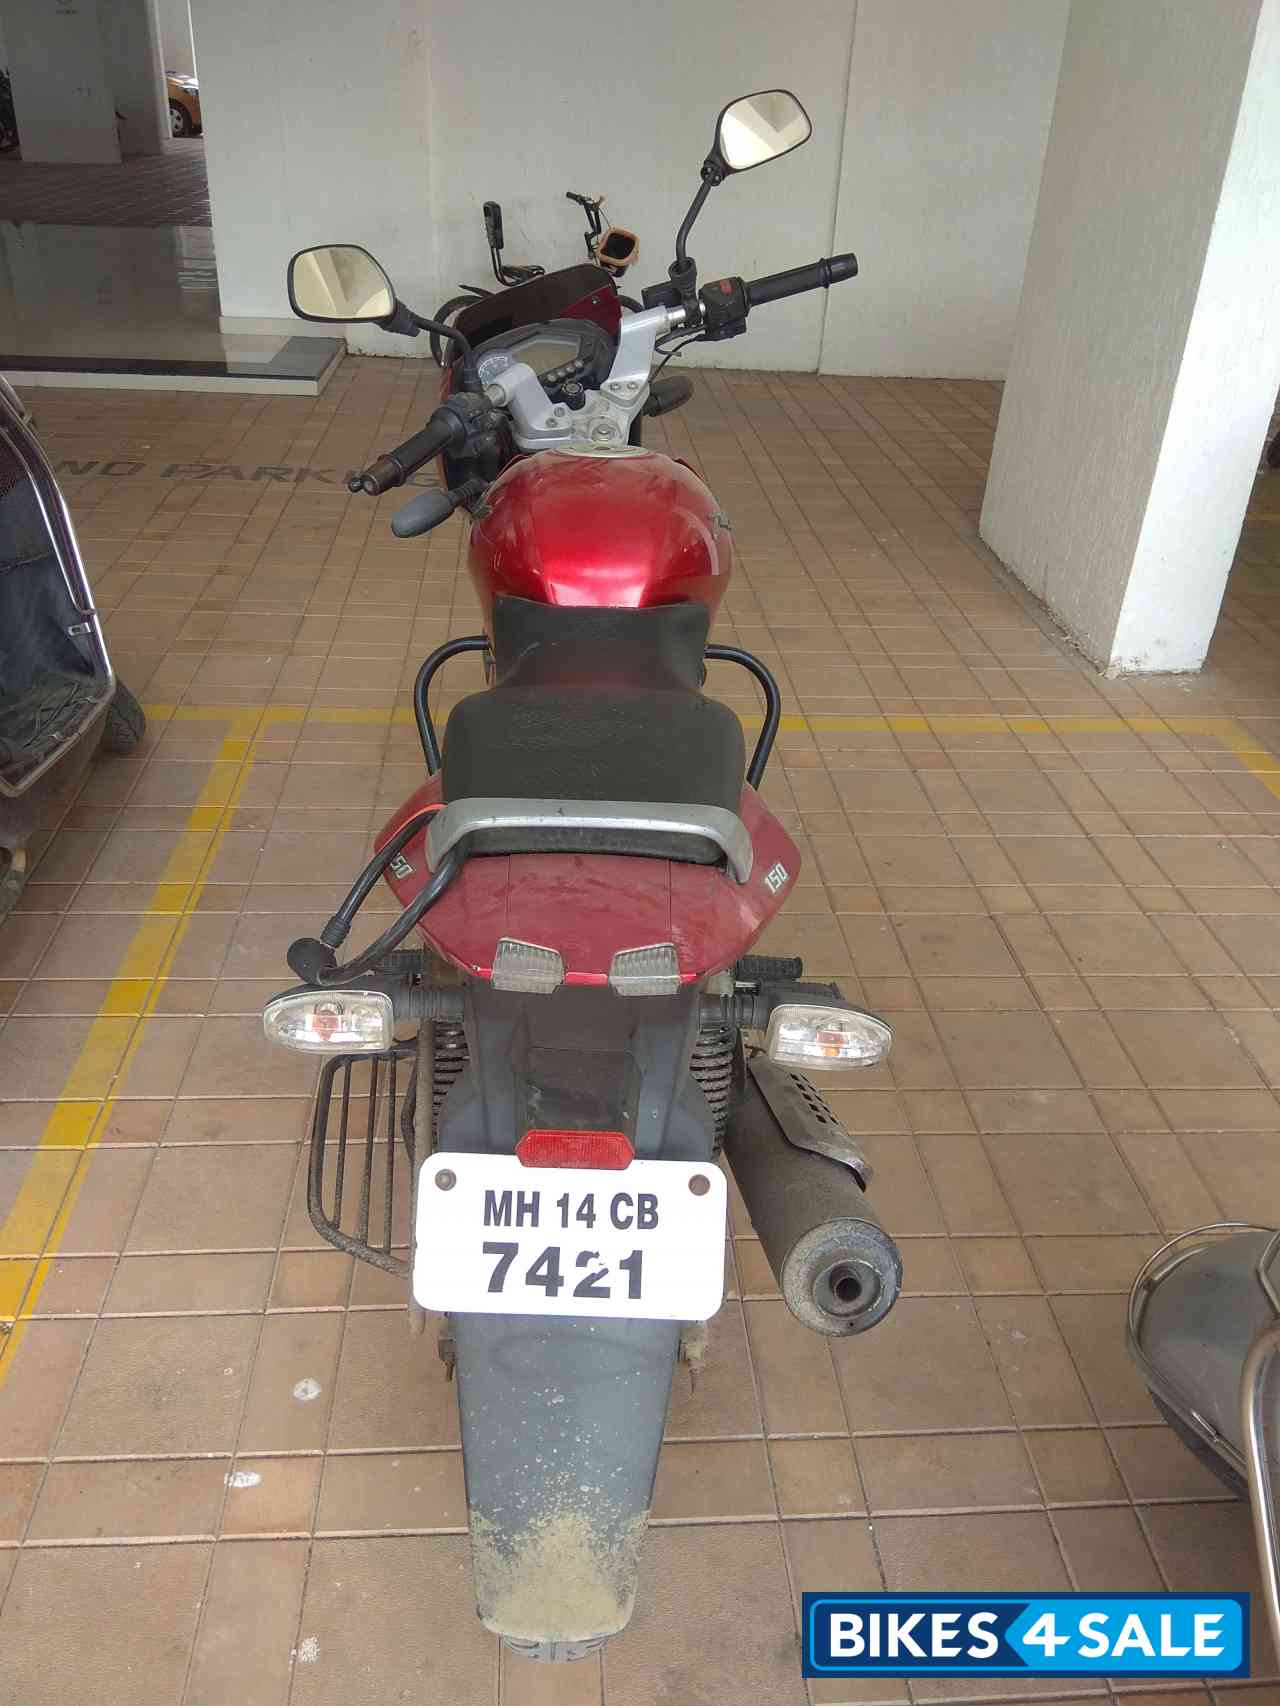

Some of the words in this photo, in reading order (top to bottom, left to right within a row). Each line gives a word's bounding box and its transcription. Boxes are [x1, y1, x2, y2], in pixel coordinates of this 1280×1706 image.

[58, 461, 147, 476] NO
[160, 464, 442, 488] PARKG
[390, 851, 416, 879] 50
[764, 863, 788, 894] 150
[483, 1190, 541, 1227] MH
[556, 1193, 597, 1229] 14
[609, 1192, 659, 1230] CB
[482, 1241, 643, 1300] 7421
